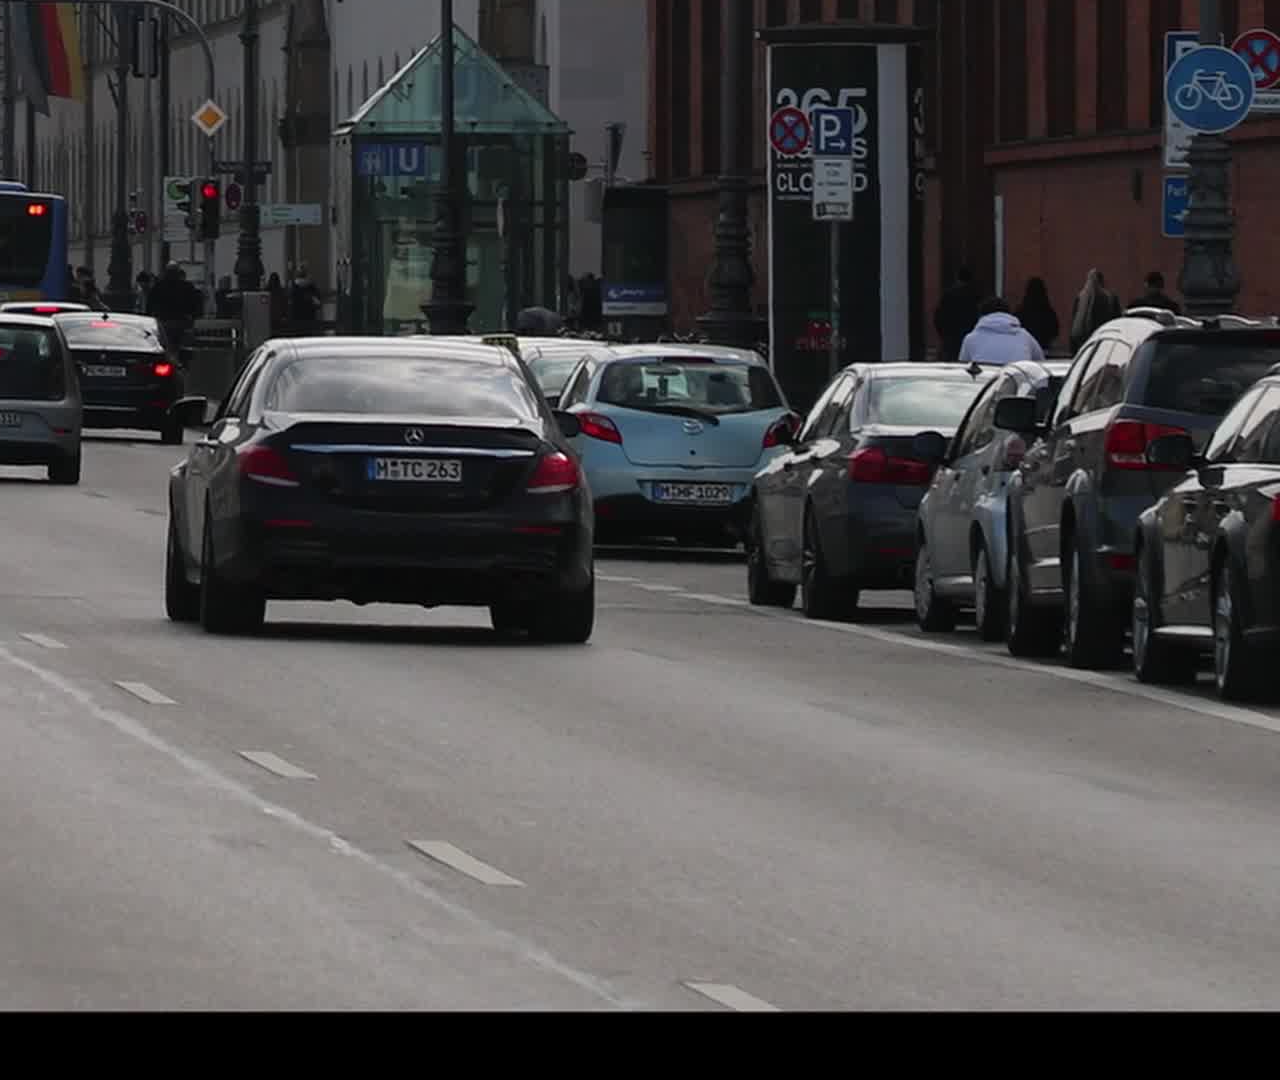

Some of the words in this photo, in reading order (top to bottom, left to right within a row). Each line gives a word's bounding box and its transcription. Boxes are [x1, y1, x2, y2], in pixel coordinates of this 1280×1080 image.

[820, 115, 841, 151] P
[399, 147, 418, 172] U
[776, 173, 868, 192] CLOD
[376, 462, 389, 477] M
[400, 461, 423, 478] TC
[426, 462, 460, 480] 263
